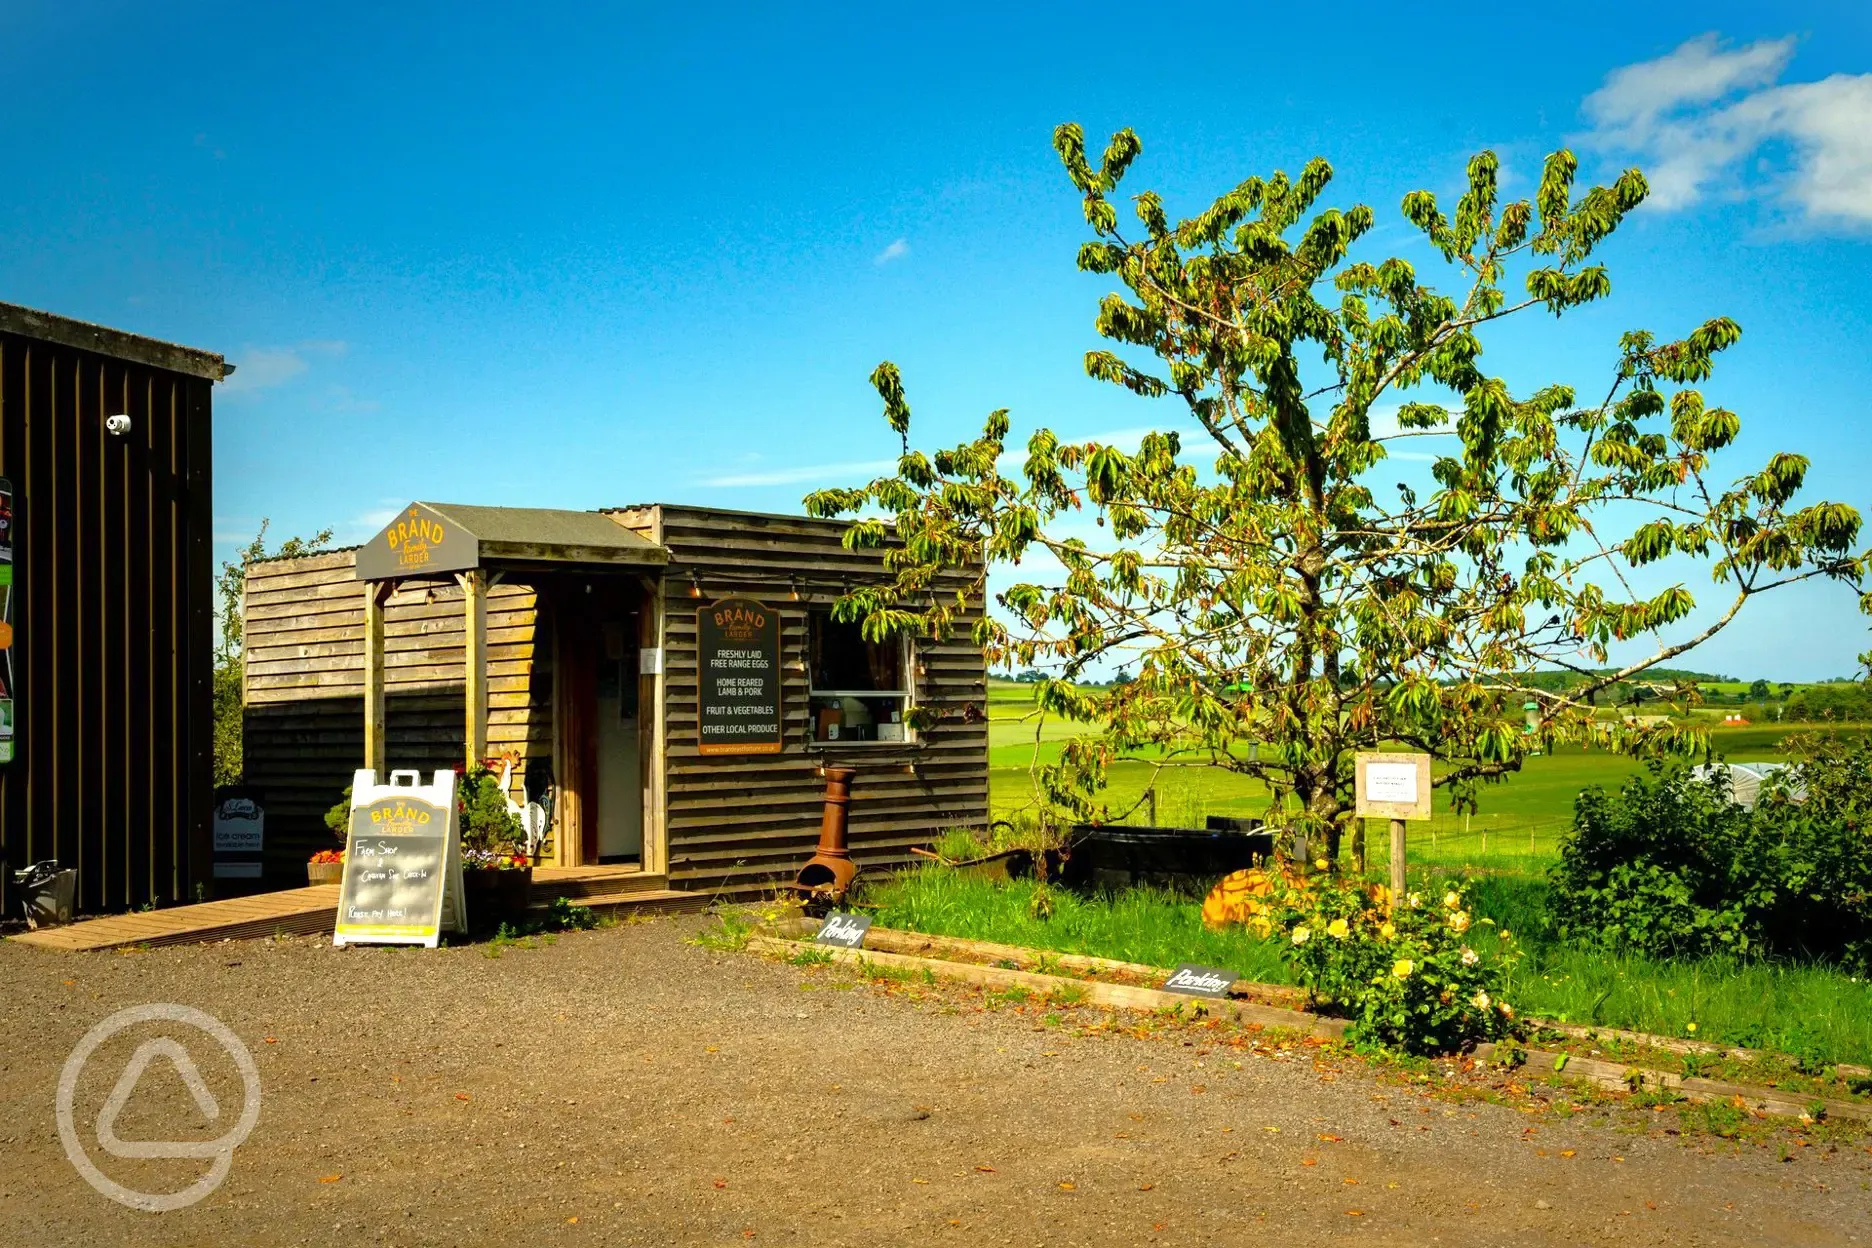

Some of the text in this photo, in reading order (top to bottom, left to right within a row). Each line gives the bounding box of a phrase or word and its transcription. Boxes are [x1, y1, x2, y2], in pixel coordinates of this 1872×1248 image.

[387, 518, 444, 549] BRAND
[399, 552, 429, 565] LARDER
[714, 608, 765, 628] BRAND
[725, 630, 753, 638] LARDER
[717, 649, 762, 659] FRESHLY LAID
[710, 659, 769, 669] FREE RANGE EGGS
[716, 678, 764, 687] HOME REARED
[718, 687, 763, 696] LAMB & PORK
[706, 705, 774, 715] FRUIT & VEGETABLES
[702, 724, 778, 734] OTHER LOCAL PRODUCE
[371, 806, 430, 824] BRAND
[817, 916, 865, 946] Parking
[1166, 968, 1231, 993] Parking
